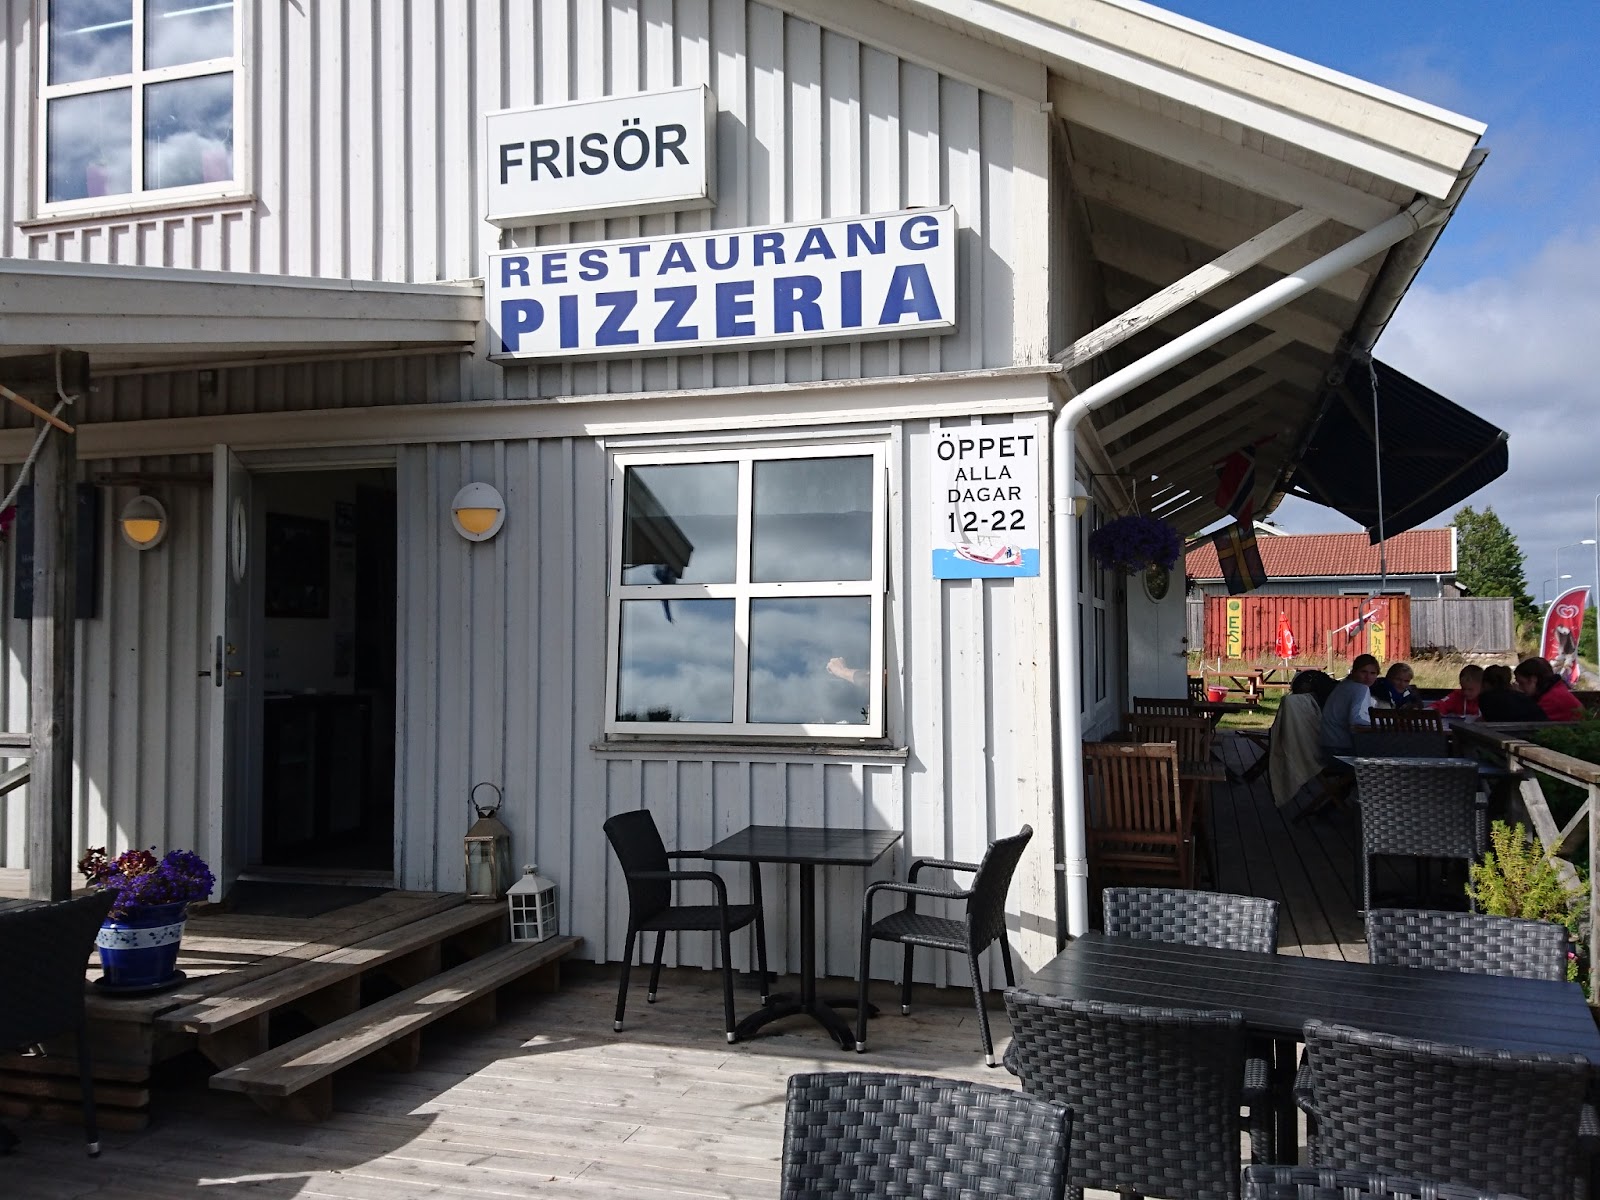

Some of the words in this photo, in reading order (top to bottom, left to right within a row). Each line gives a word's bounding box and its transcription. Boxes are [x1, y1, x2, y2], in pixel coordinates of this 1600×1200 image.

[500, 117, 690, 185] FRISÖR
[501, 215, 940, 288] RESTAURANG
[501, 263, 943, 353] PIZZERIA
[937, 433, 1034, 461] ÖPPET
[955, 465, 1012, 481] ALLA
[948, 486, 1022, 504] DAGAR
[948, 509, 1026, 533] 12-22
